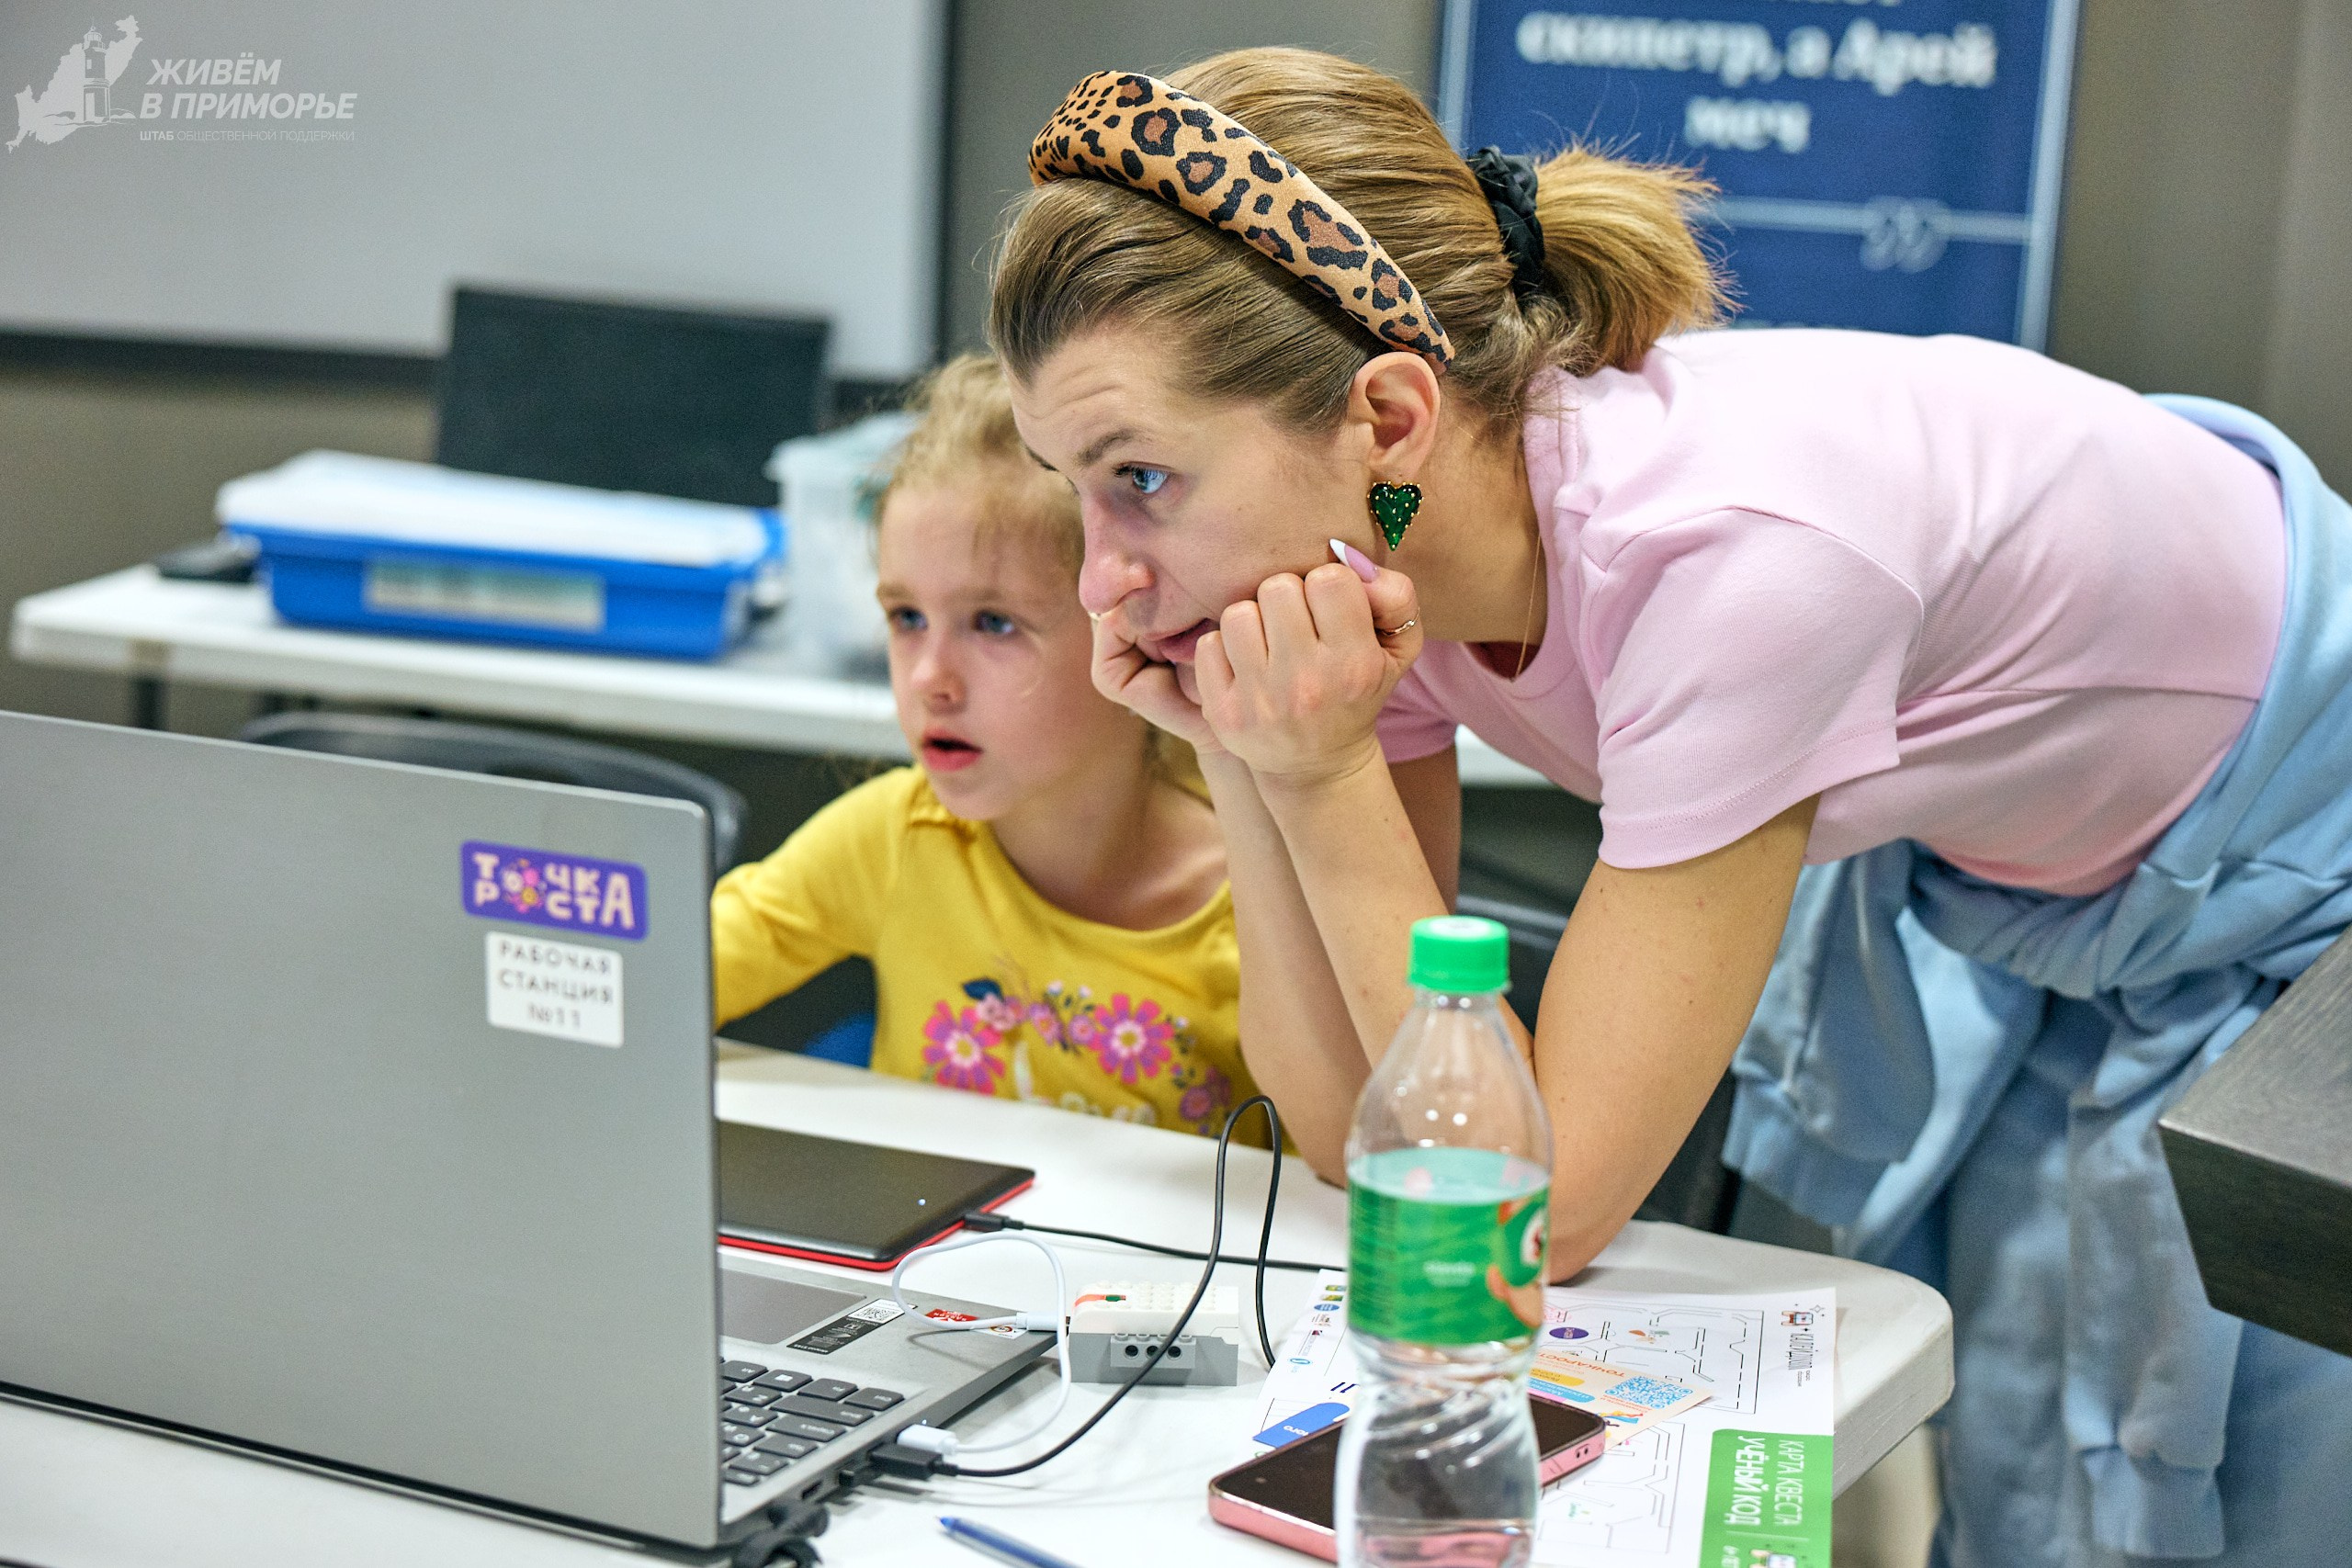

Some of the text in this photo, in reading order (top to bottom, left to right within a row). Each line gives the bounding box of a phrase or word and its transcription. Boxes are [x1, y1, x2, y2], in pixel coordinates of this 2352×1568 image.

[472, 852, 636, 930] ТОЧКА
[498, 940, 611, 975] РАБОЧАЯ
[498, 969, 614, 1004] СТАНЦИЯ
[1734, 1436, 1770, 1494] УЧЁНЫЙ
[1774, 1439, 1805, 1525] КАРТА КВЕСТА
[1724, 1495, 1762, 1525] КОД
